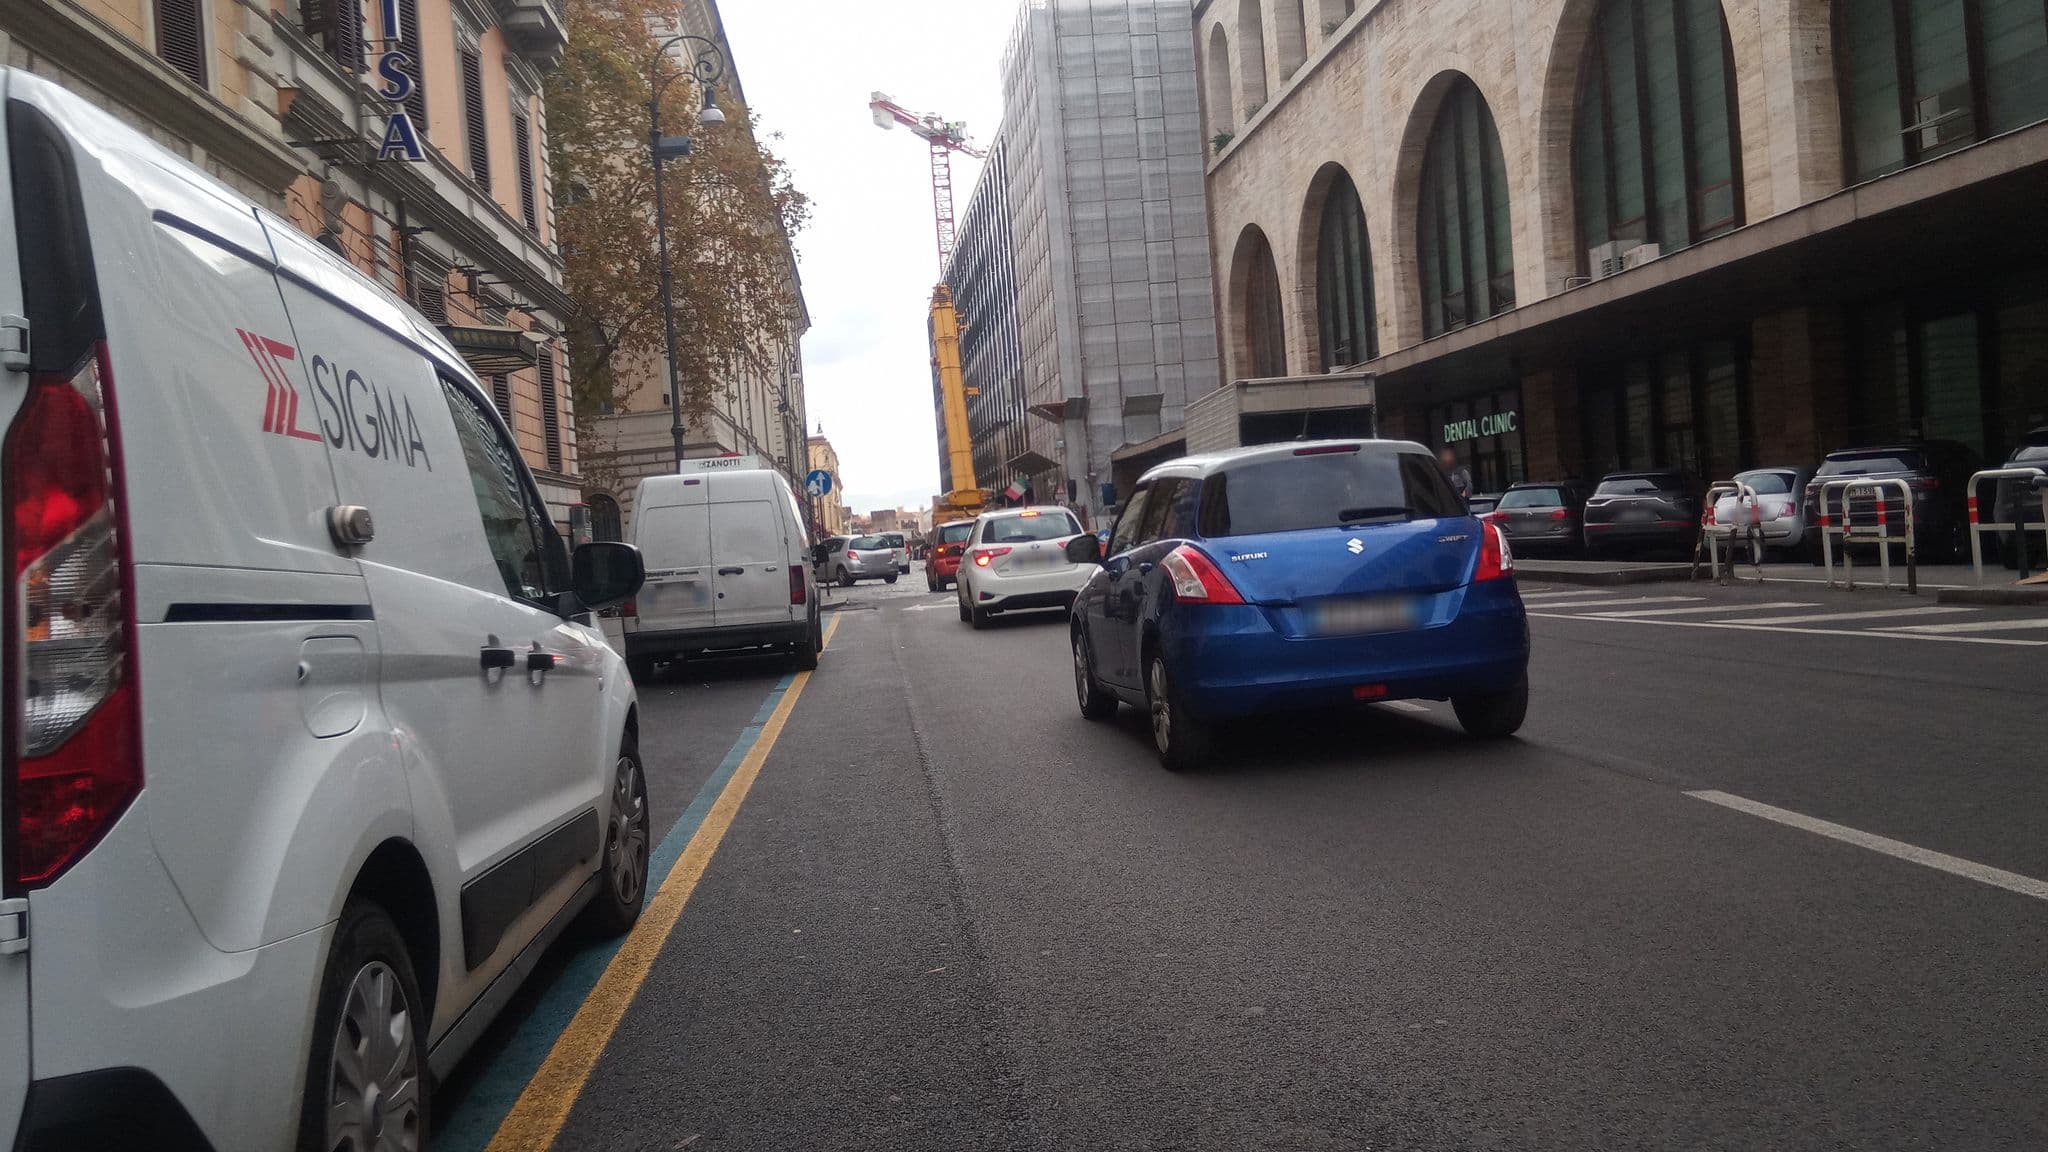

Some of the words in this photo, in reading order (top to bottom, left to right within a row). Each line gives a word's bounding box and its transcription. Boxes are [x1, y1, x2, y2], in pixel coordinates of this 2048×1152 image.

[312, 354, 432, 472] SIGMA
[1444, 419, 1478, 442] DENTAL
[1481, 410, 1516, 436] CLINIC
[706, 459, 740, 468] ZANOTTI
[1231, 552, 1268, 562] SUZUKI
